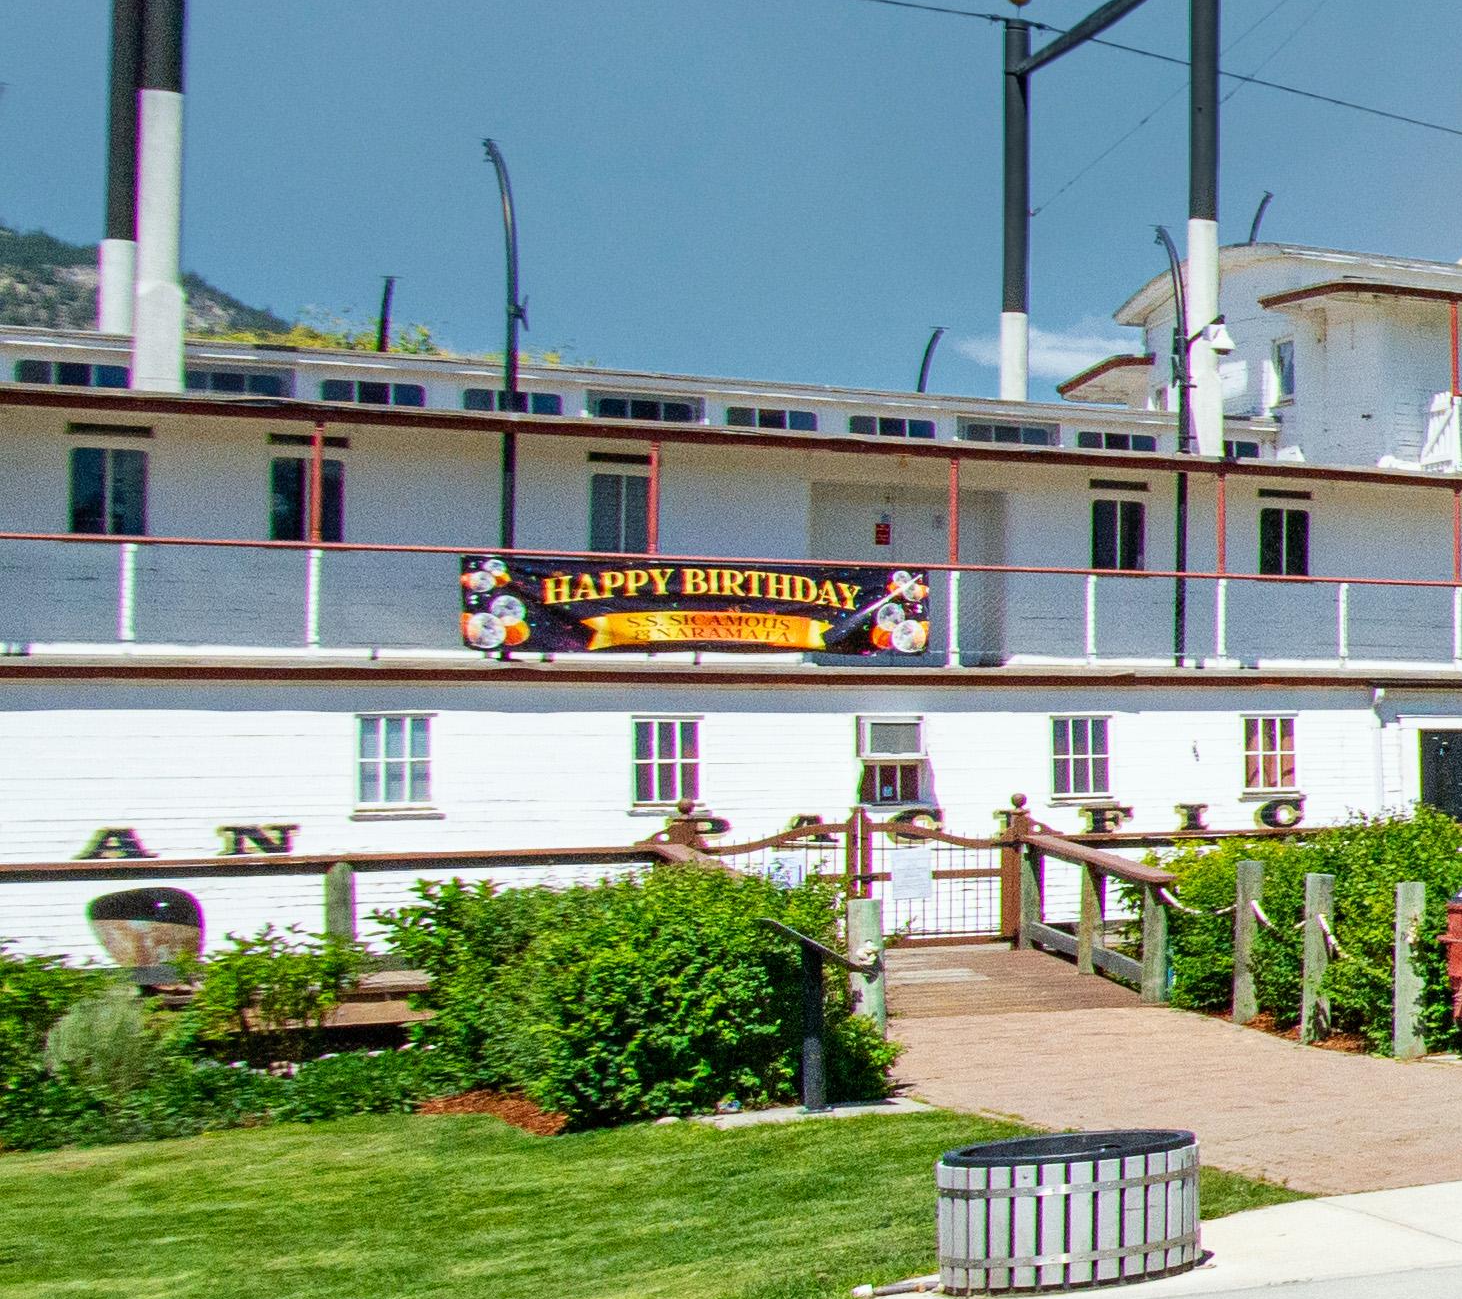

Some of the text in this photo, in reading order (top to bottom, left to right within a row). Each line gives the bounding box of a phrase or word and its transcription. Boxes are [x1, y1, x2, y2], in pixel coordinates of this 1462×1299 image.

[543, 568, 861, 611] HAPPY BIRTHDAY
[627, 614, 790, 631] S.S. SICAMOUS
[655, 627, 791, 643] NARAMATA
